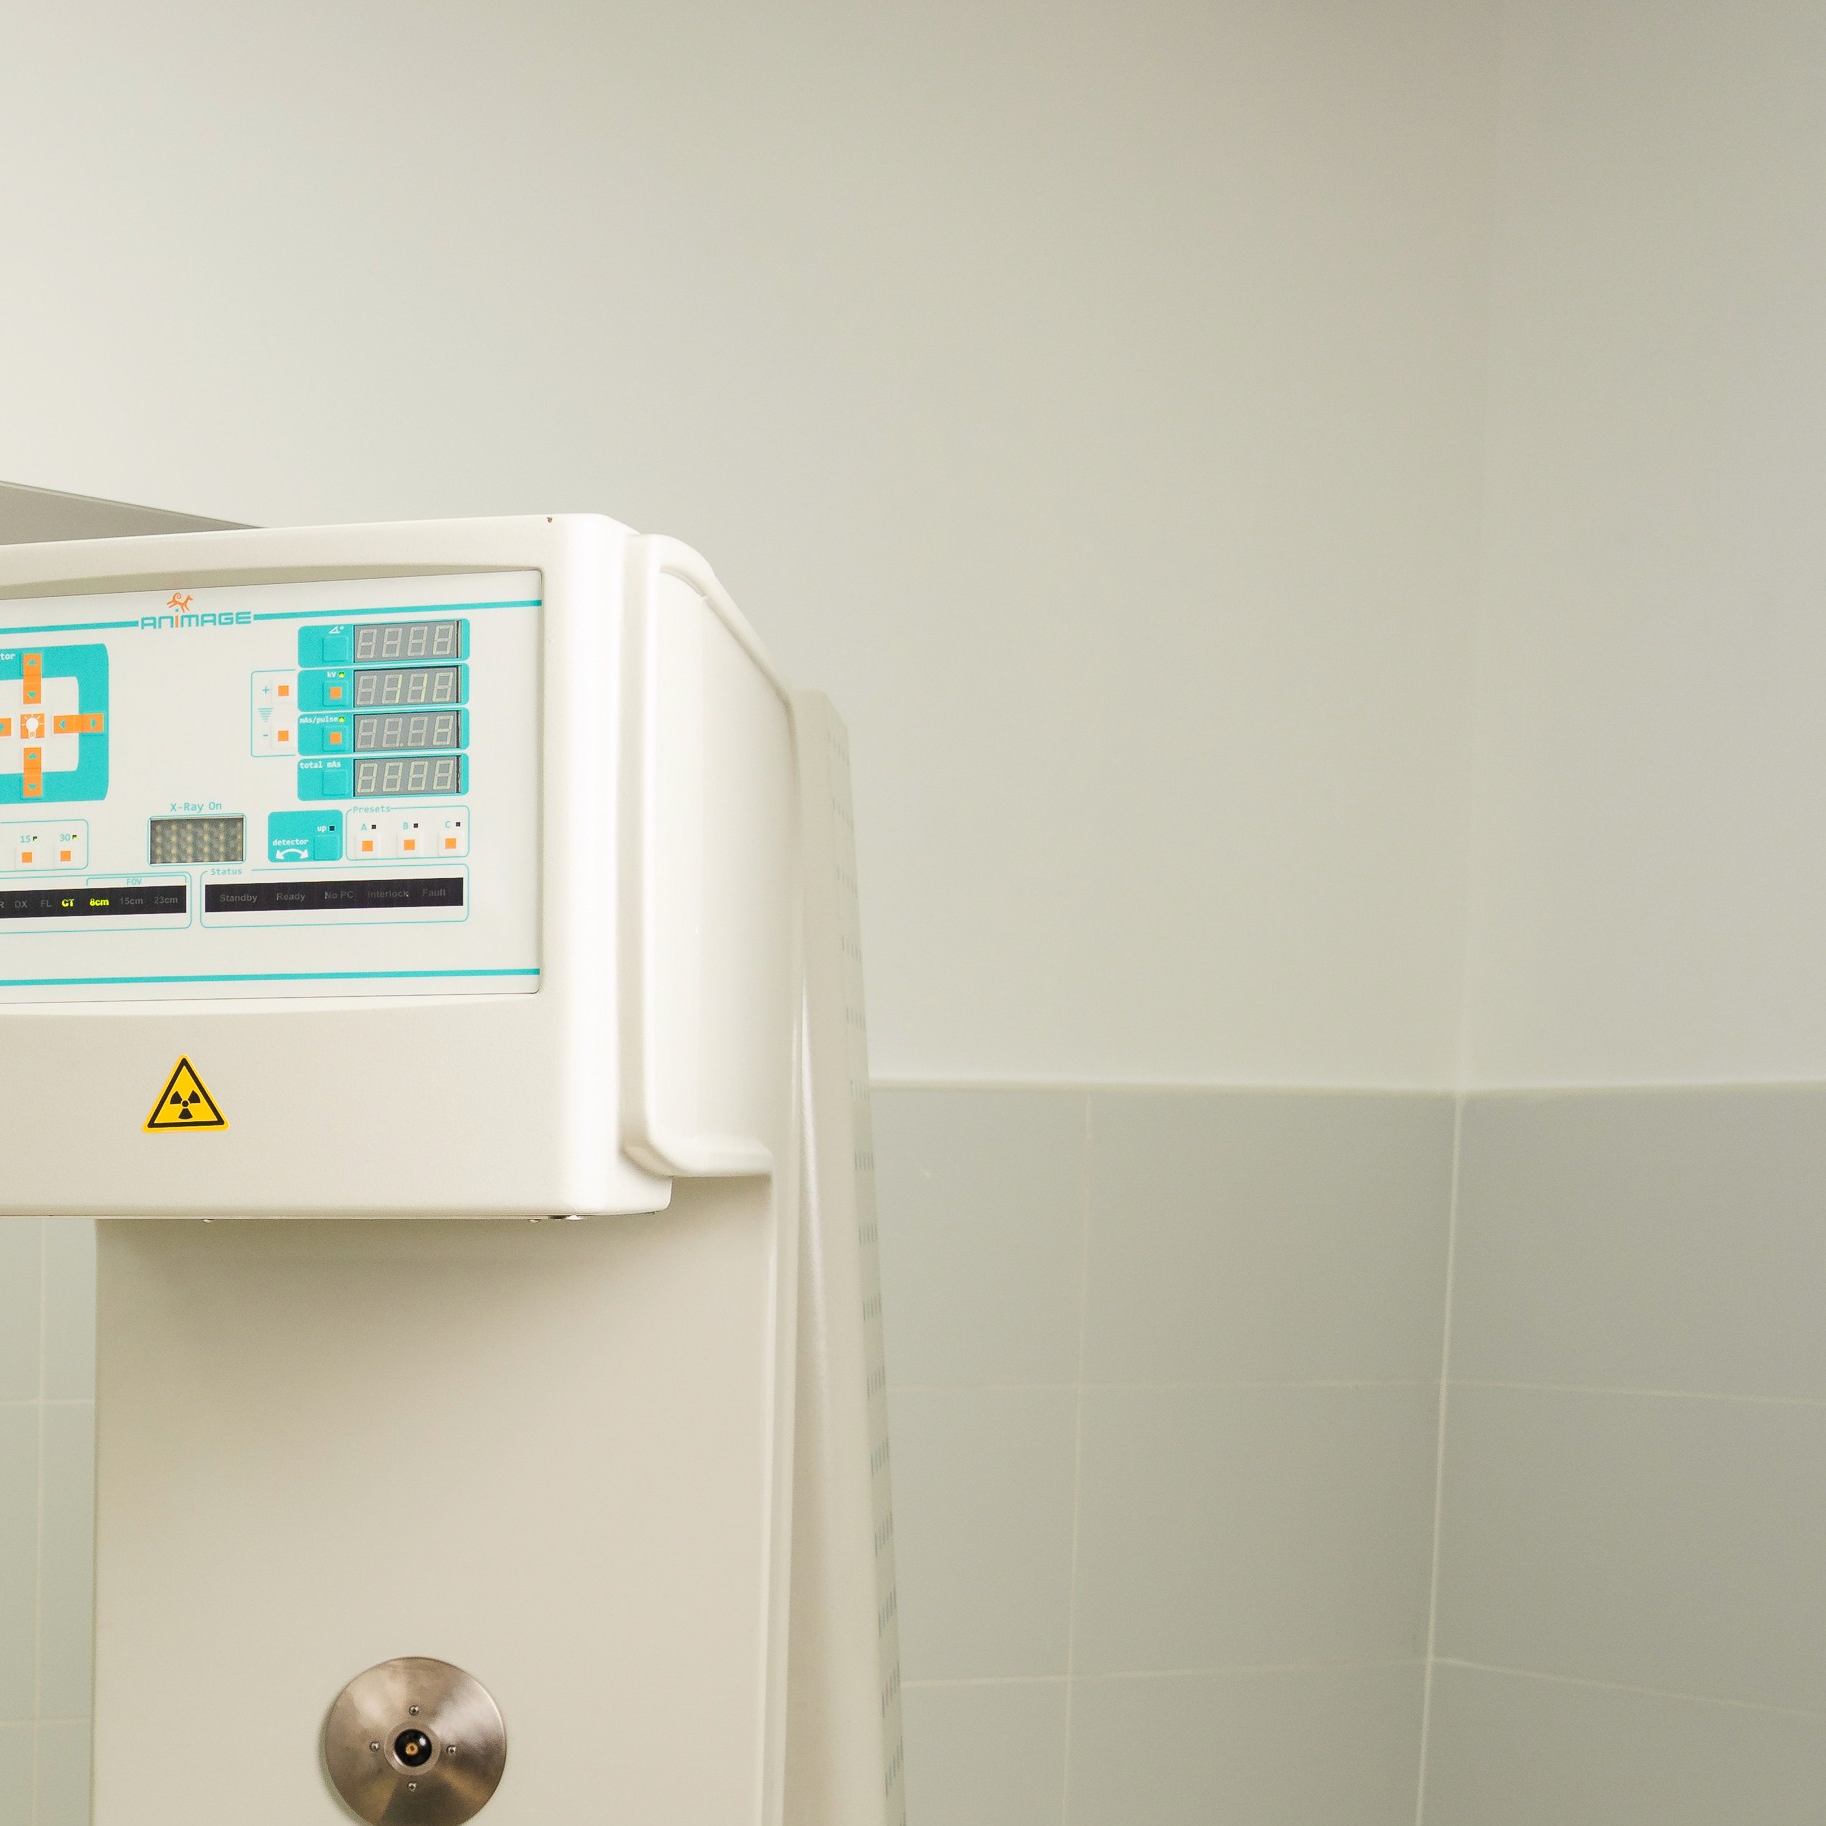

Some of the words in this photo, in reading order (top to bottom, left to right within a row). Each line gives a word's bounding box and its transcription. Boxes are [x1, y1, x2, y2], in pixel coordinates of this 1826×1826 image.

[300, 716, 338, 724] mAs/pulse
[300, 761, 322, 769] total
[327, 760, 341, 768] mAs
[170, 802, 203, 813] X-Ray
[208, 802, 222, 811] On
[353, 806, 391, 814] Presets
[403, 822, 409, 830] B
[445, 820, 451, 828] C
[21, 835, 31, 843] 15
[60, 834, 71, 842] 30
[272, 838, 309, 846] detector
[211, 868, 243, 876] Status
[325, 891, 337, 900] No
[340, 891, 354, 899] PC
[367, 889, 409, 898] Interlock
[422, 888, 446, 897] Fault
[119, 897, 143, 905] 15cm
[154, 896, 179, 904] 23cm
[219, 894, 257, 903] Standby
[277, 892, 305, 902] Ready
[15, 900, 28, 908] DX
[41, 900, 52, 908] FL
[61, 898, 75, 908] CT
[89, 898, 109, 907] 8cm
